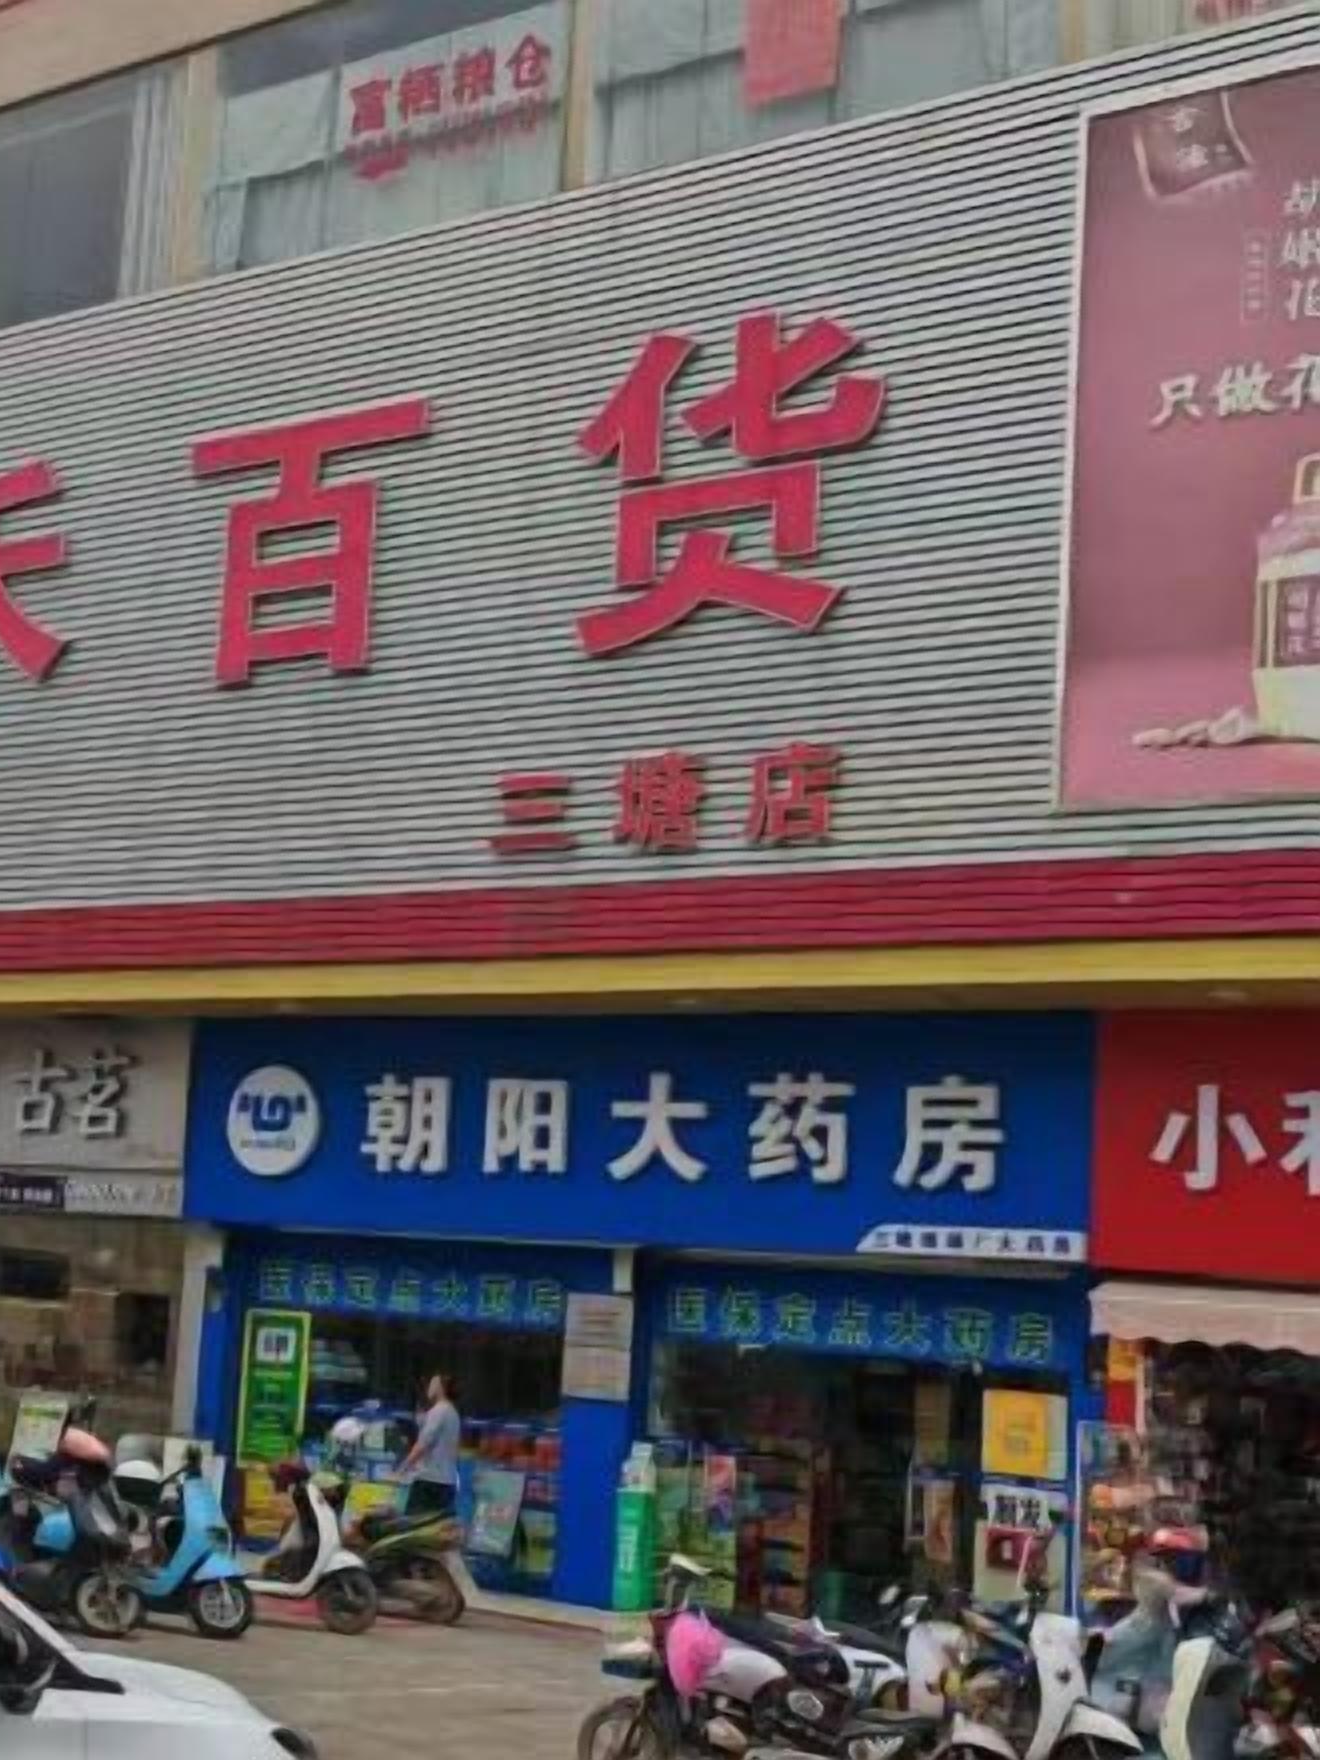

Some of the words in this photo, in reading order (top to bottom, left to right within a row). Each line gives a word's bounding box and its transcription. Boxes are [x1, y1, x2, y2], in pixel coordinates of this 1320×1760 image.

[488, 741, 842, 856] 三塘店
[13, 1047, 132, 1140] 古茗
[360, 1072, 1006, 1192] 朝阳大药房
